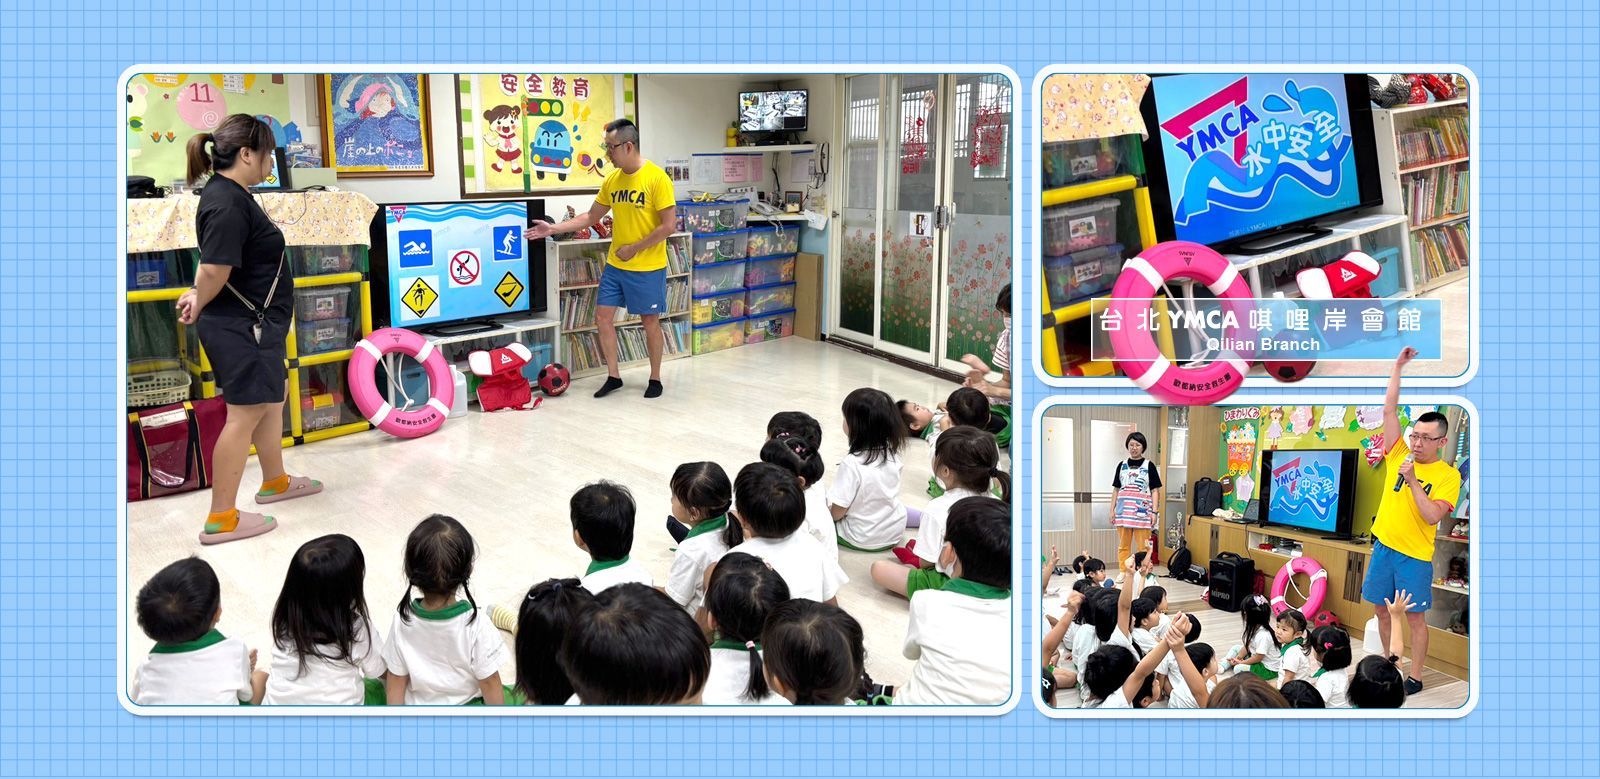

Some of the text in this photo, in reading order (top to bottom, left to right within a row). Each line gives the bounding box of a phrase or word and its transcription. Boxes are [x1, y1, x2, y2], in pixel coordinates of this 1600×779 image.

[189, 82, 214, 103] 11
[501, 73, 589, 97] 安全教育
[1176, 103, 1260, 163] YMCA
[1240, 110, 1343, 178] 水中安全
[610, 189, 646, 206] YMCA
[1224, 407, 1261, 422] ひまわりくみ
[1274, 467, 1303, 488] YMCA
[1292, 477, 1335, 501] 水中安全
